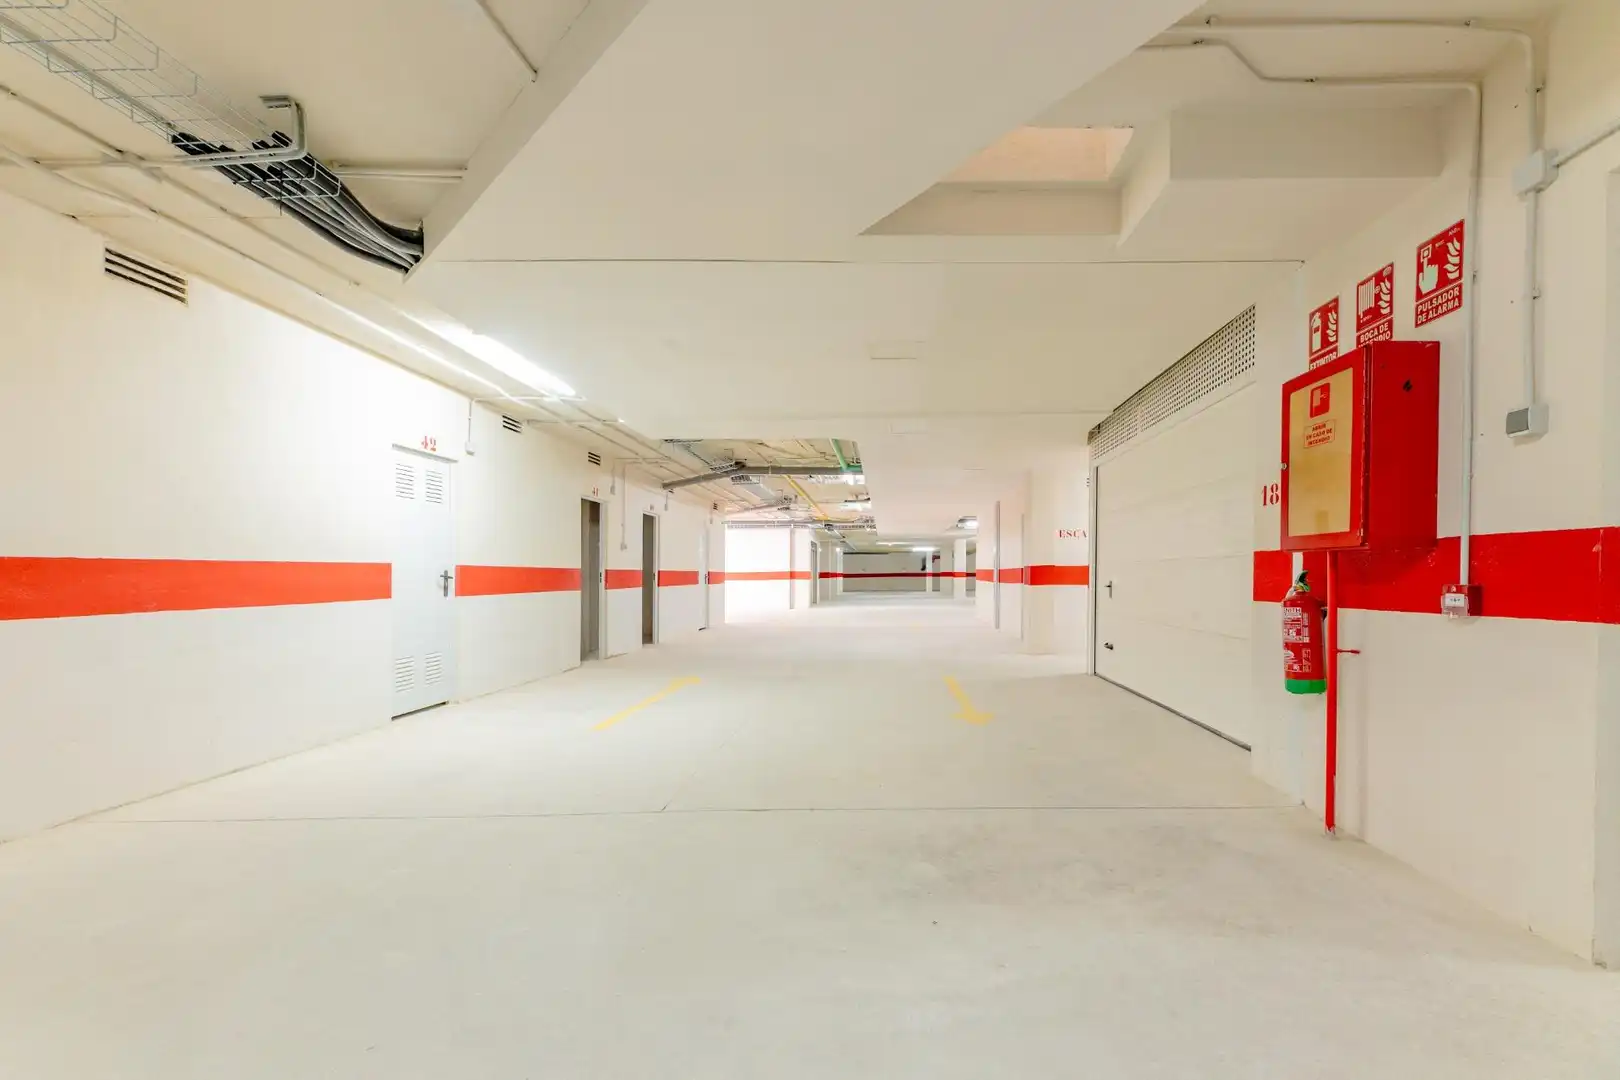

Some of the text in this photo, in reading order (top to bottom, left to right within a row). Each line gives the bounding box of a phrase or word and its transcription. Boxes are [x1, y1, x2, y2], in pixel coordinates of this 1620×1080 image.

[1417, 286, 1460, 315] PULSADOR
[1417, 297, 1460, 325] DE ALARMA
[1360, 322, 1389, 343] BOCA DE
[420, 435, 437, 451] 42
[1261, 483, 1280, 506] 18
